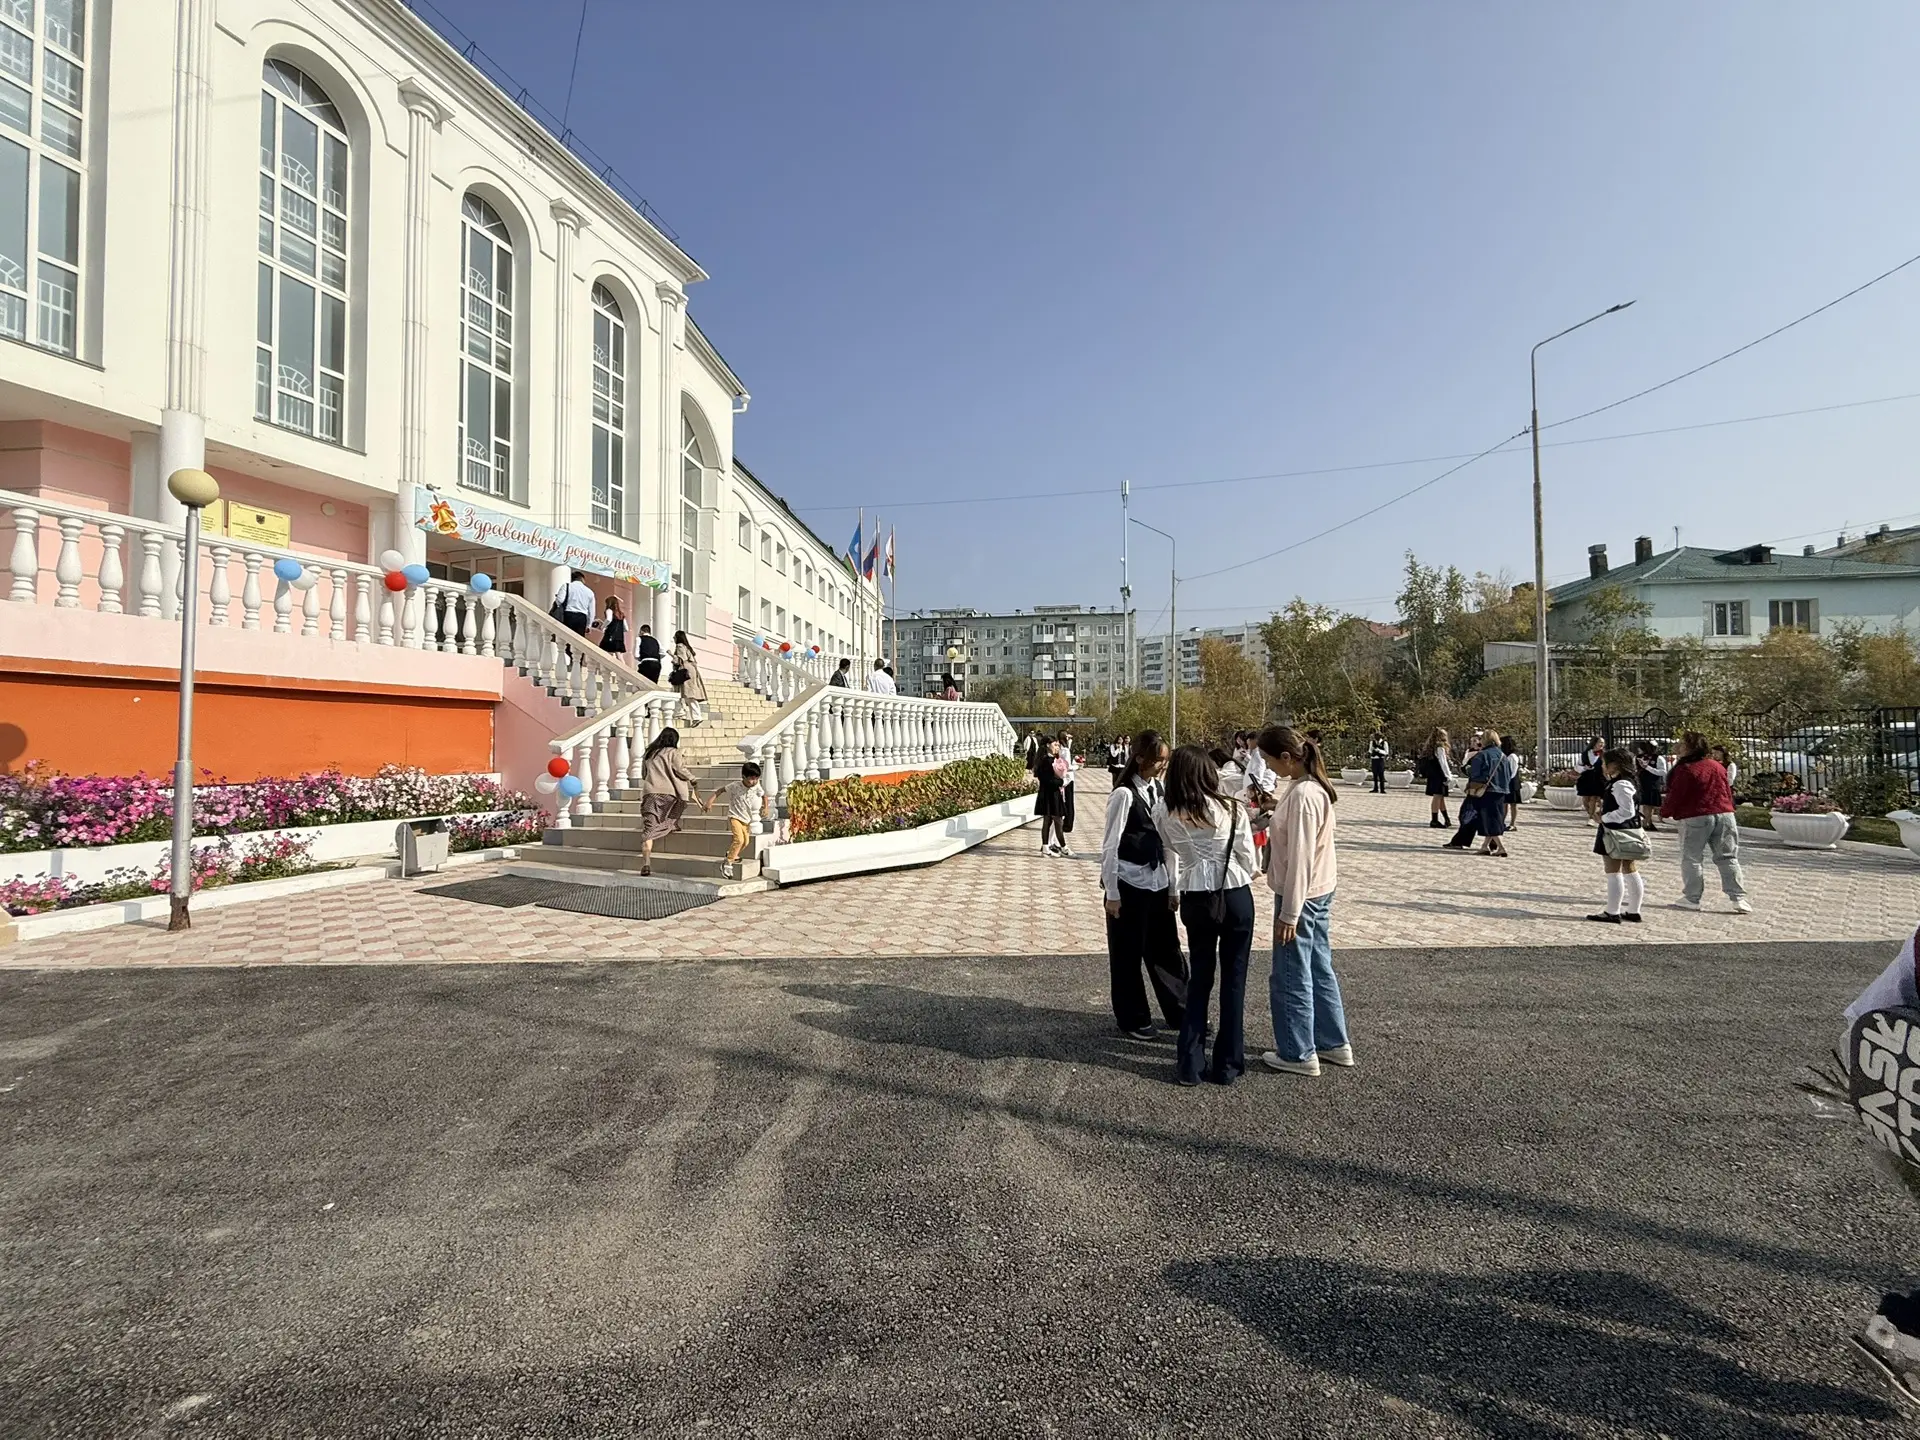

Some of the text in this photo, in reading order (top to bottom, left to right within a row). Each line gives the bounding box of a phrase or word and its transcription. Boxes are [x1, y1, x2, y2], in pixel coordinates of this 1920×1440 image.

[460, 507, 656, 578] Здравствуй, родная школа!
